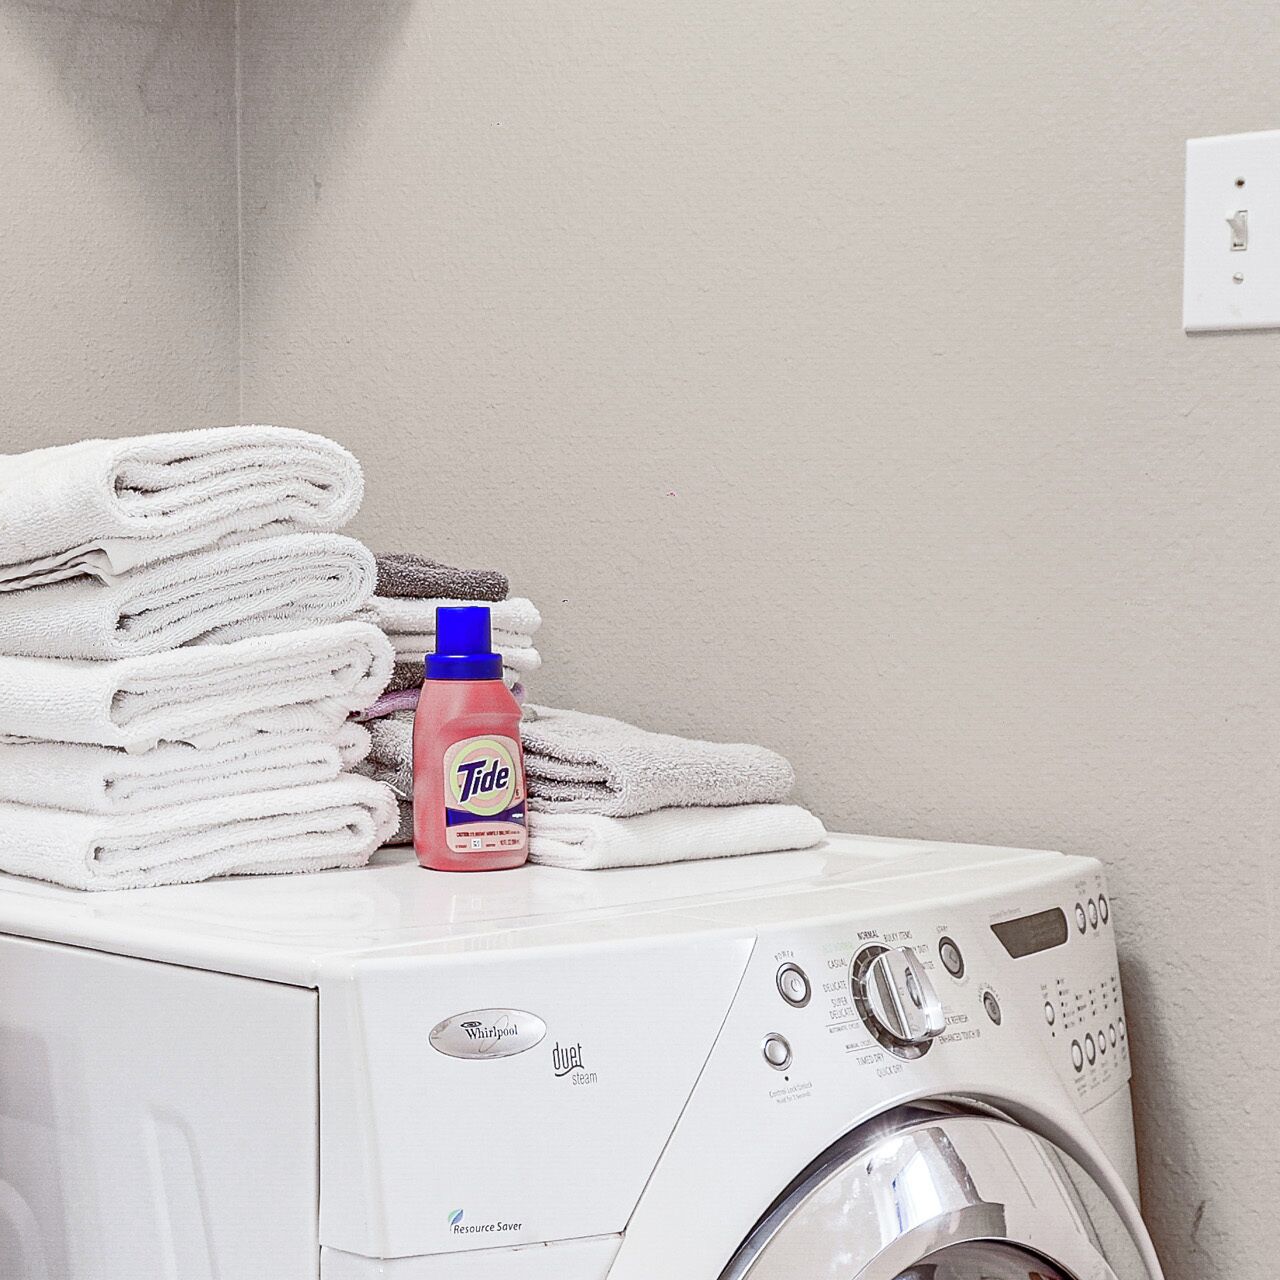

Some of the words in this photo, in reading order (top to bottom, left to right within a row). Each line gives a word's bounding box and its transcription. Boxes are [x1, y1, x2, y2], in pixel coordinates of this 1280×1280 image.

[457, 759, 509, 804] Tide
[857, 929, 879, 941] NORMAL
[828, 957, 848, 969] CASUAL
[822, 980, 848, 993] DELICATE
[465, 1024, 518, 1041] Whirlpool
[552, 1042, 583, 1070] duet
[572, 1071, 598, 1086] steam
[454, 1224, 495, 1235] Resource
[496, 1221, 523, 1232] Saver
